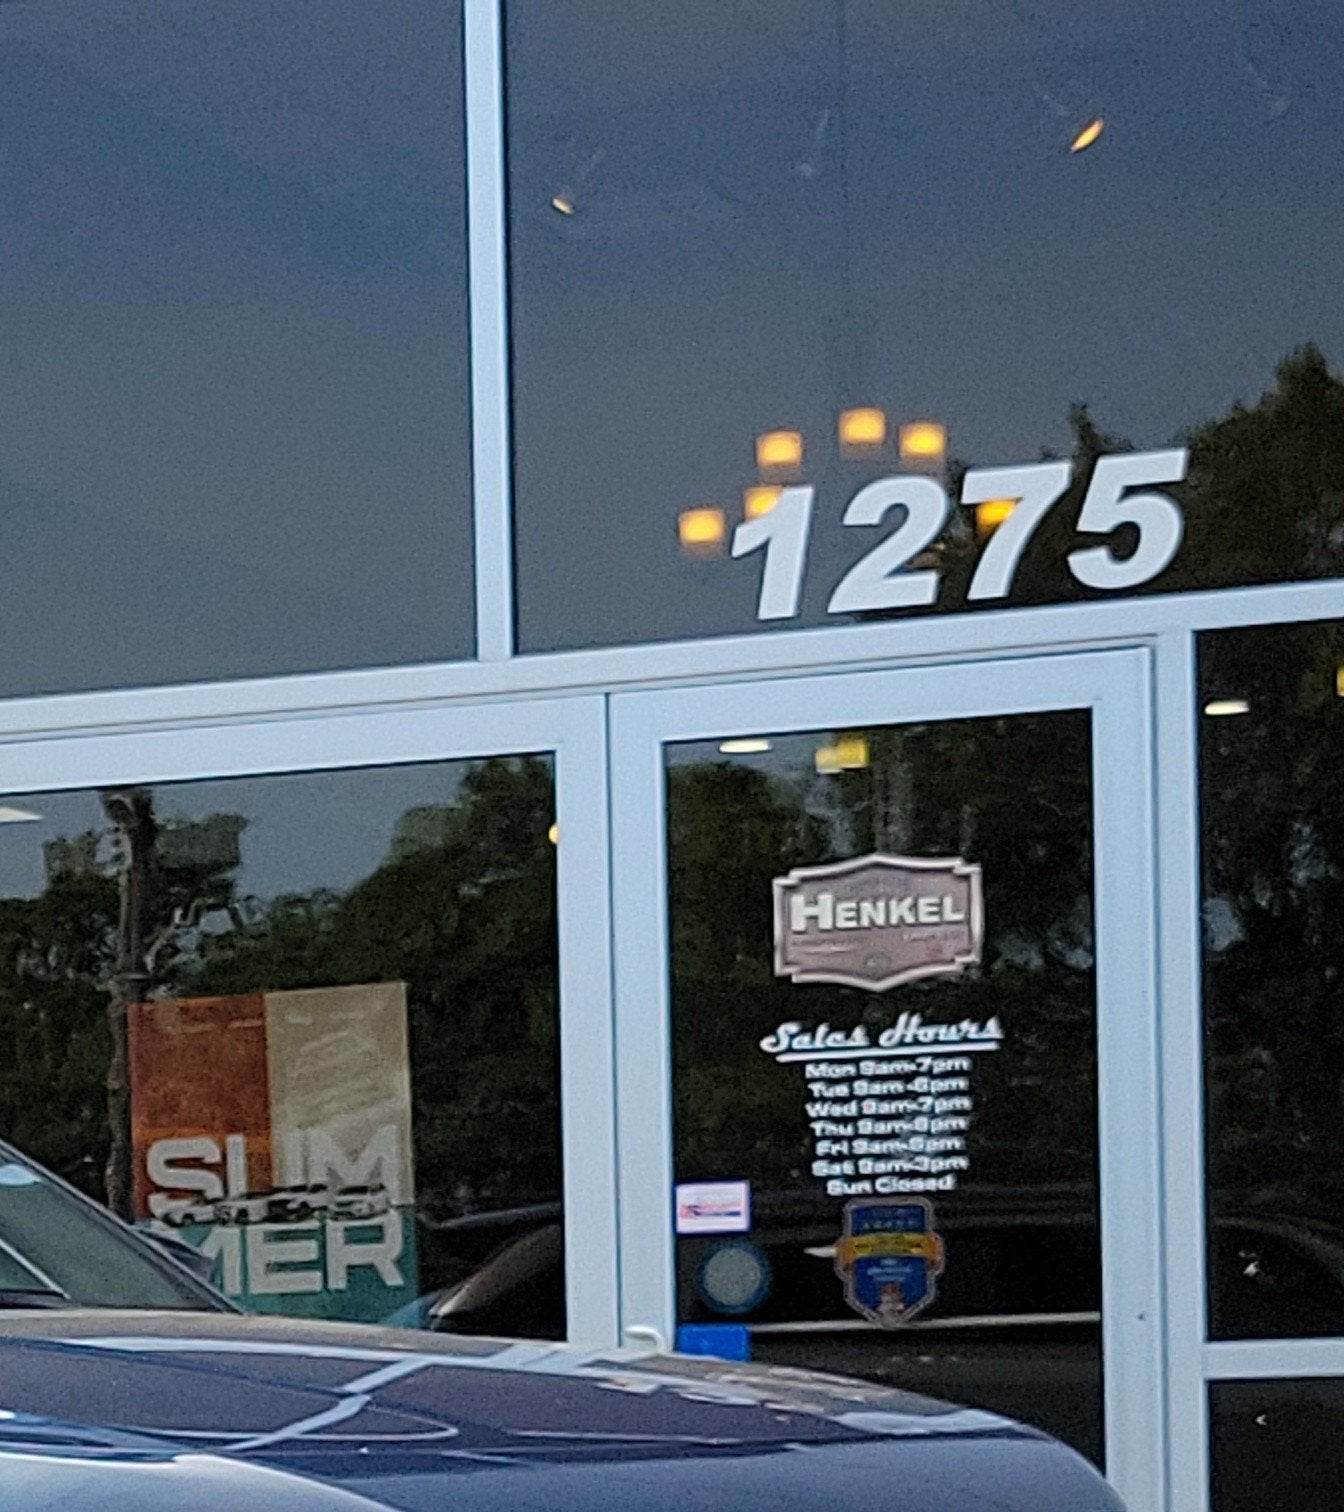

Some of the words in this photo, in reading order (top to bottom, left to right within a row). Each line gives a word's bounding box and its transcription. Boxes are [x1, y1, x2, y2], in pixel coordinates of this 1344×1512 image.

[731, 447, 1189, 621] 1275
[790, 891, 965, 933] HENKEL
[759, 1020, 870, 1053] Sales
[878, 1009, 1005, 1048] Hours
[805, 1062, 858, 1079] Mon
[808, 1081, 850, 1098] Tue
[805, 1101, 859, 1118] Wed
[809, 1120, 854, 1137] Thu
[815, 1140, 850, 1156] Fri
[812, 1159, 856, 1177] Sat
[826, 1179, 873, 1196] Sun
[874, 1173, 958, 1194] Closed
